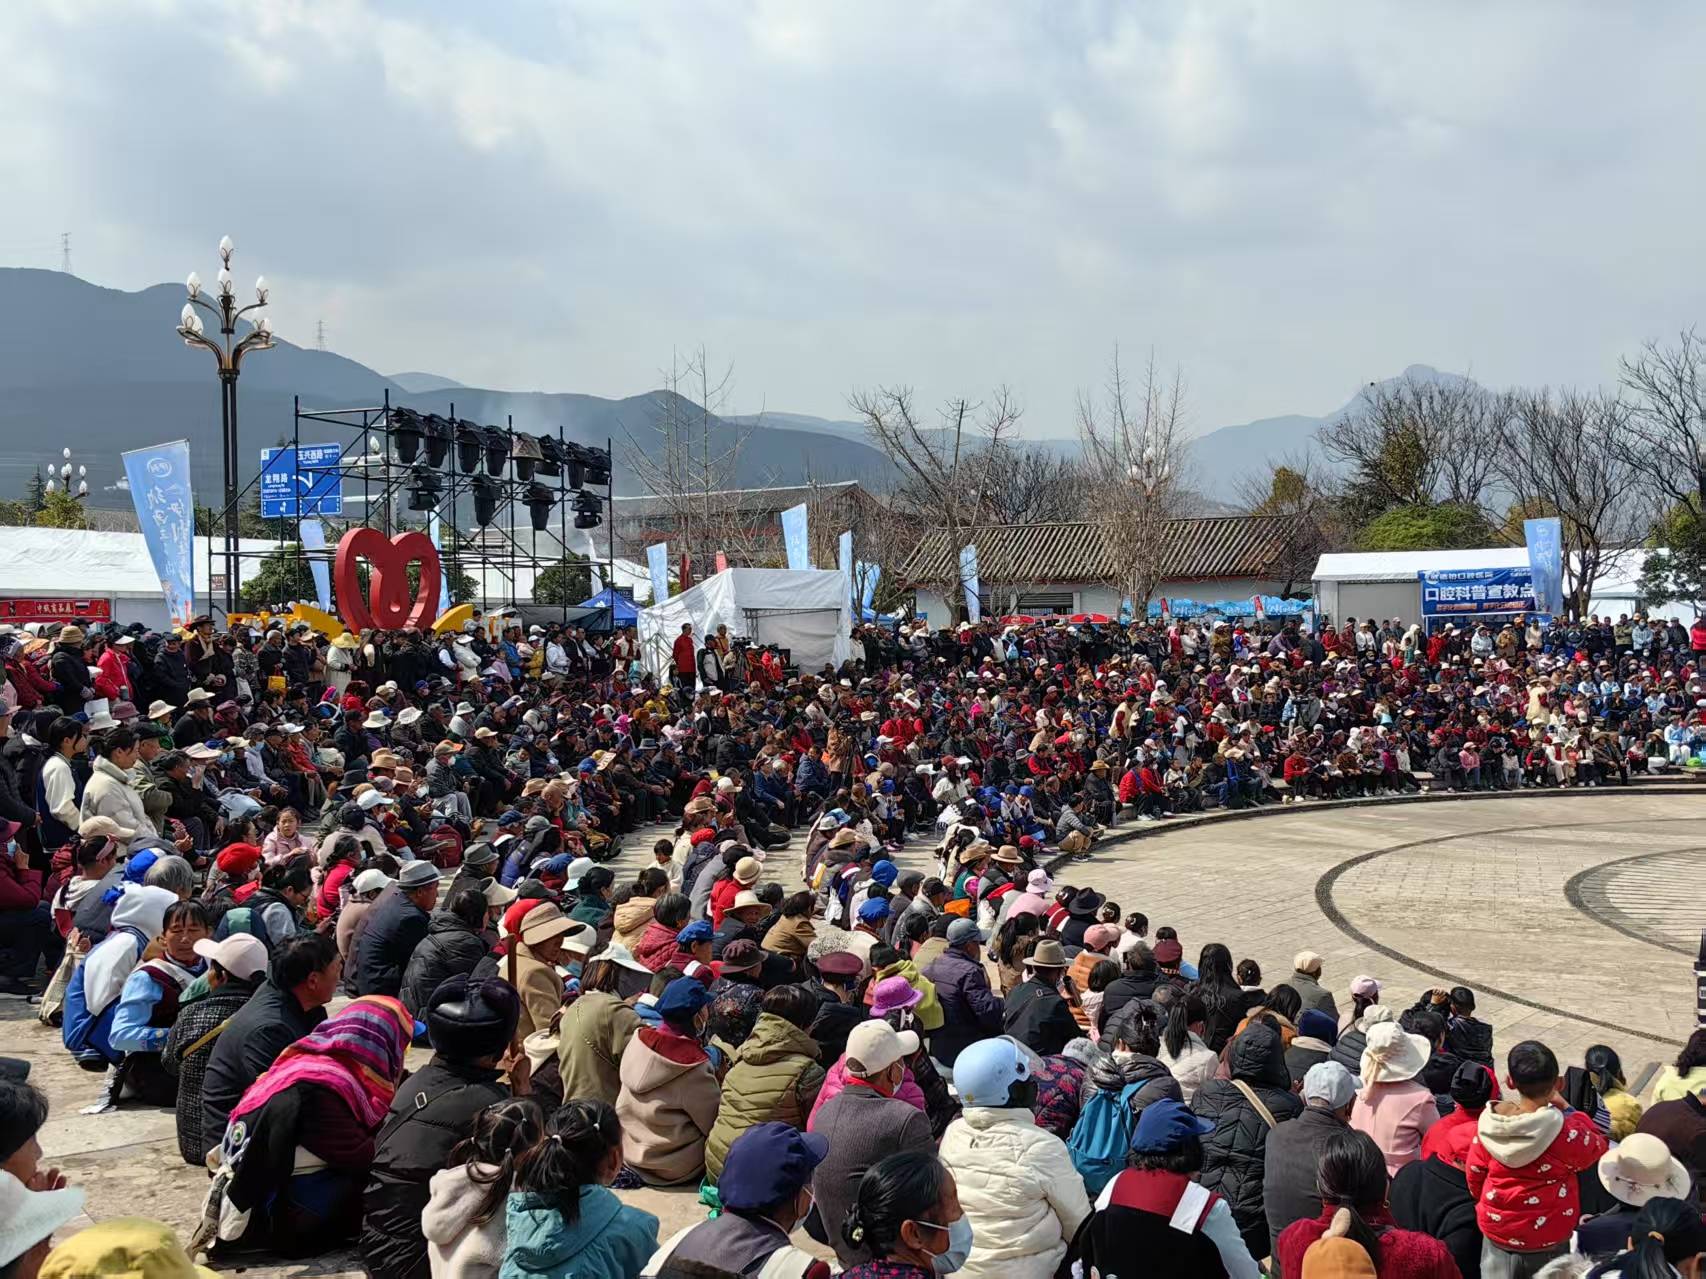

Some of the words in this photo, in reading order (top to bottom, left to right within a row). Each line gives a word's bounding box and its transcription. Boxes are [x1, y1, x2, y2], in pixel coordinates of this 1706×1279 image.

[1425, 583, 1535, 601] 口腔科普宣教点
